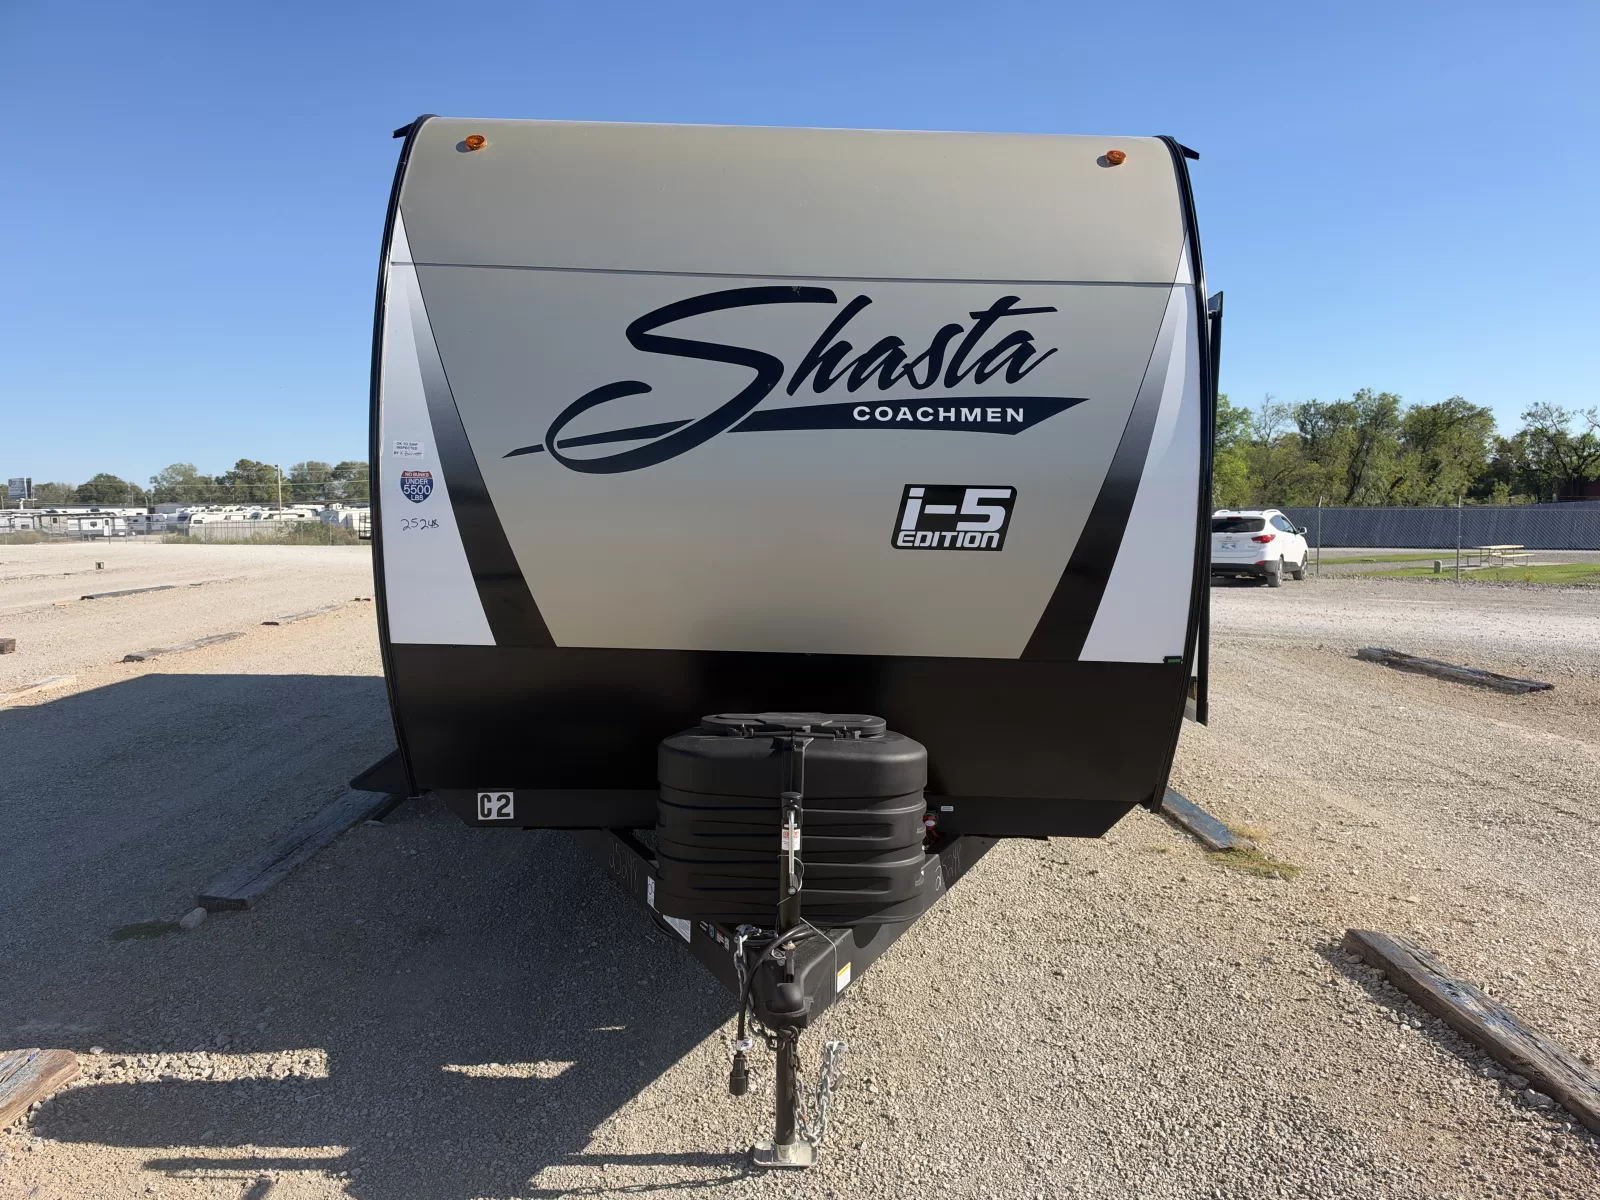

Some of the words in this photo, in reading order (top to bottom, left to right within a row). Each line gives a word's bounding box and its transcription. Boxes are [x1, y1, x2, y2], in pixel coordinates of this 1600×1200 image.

[545, 286, 1059, 474] Shasta
[852, 405, 1026, 424] COACHMEN
[403, 485, 431, 495] 5500
[901, 487, 1008, 532] i-5
[896, 530, 1000, 548] EDITION
[479, 793, 511, 818] C2
